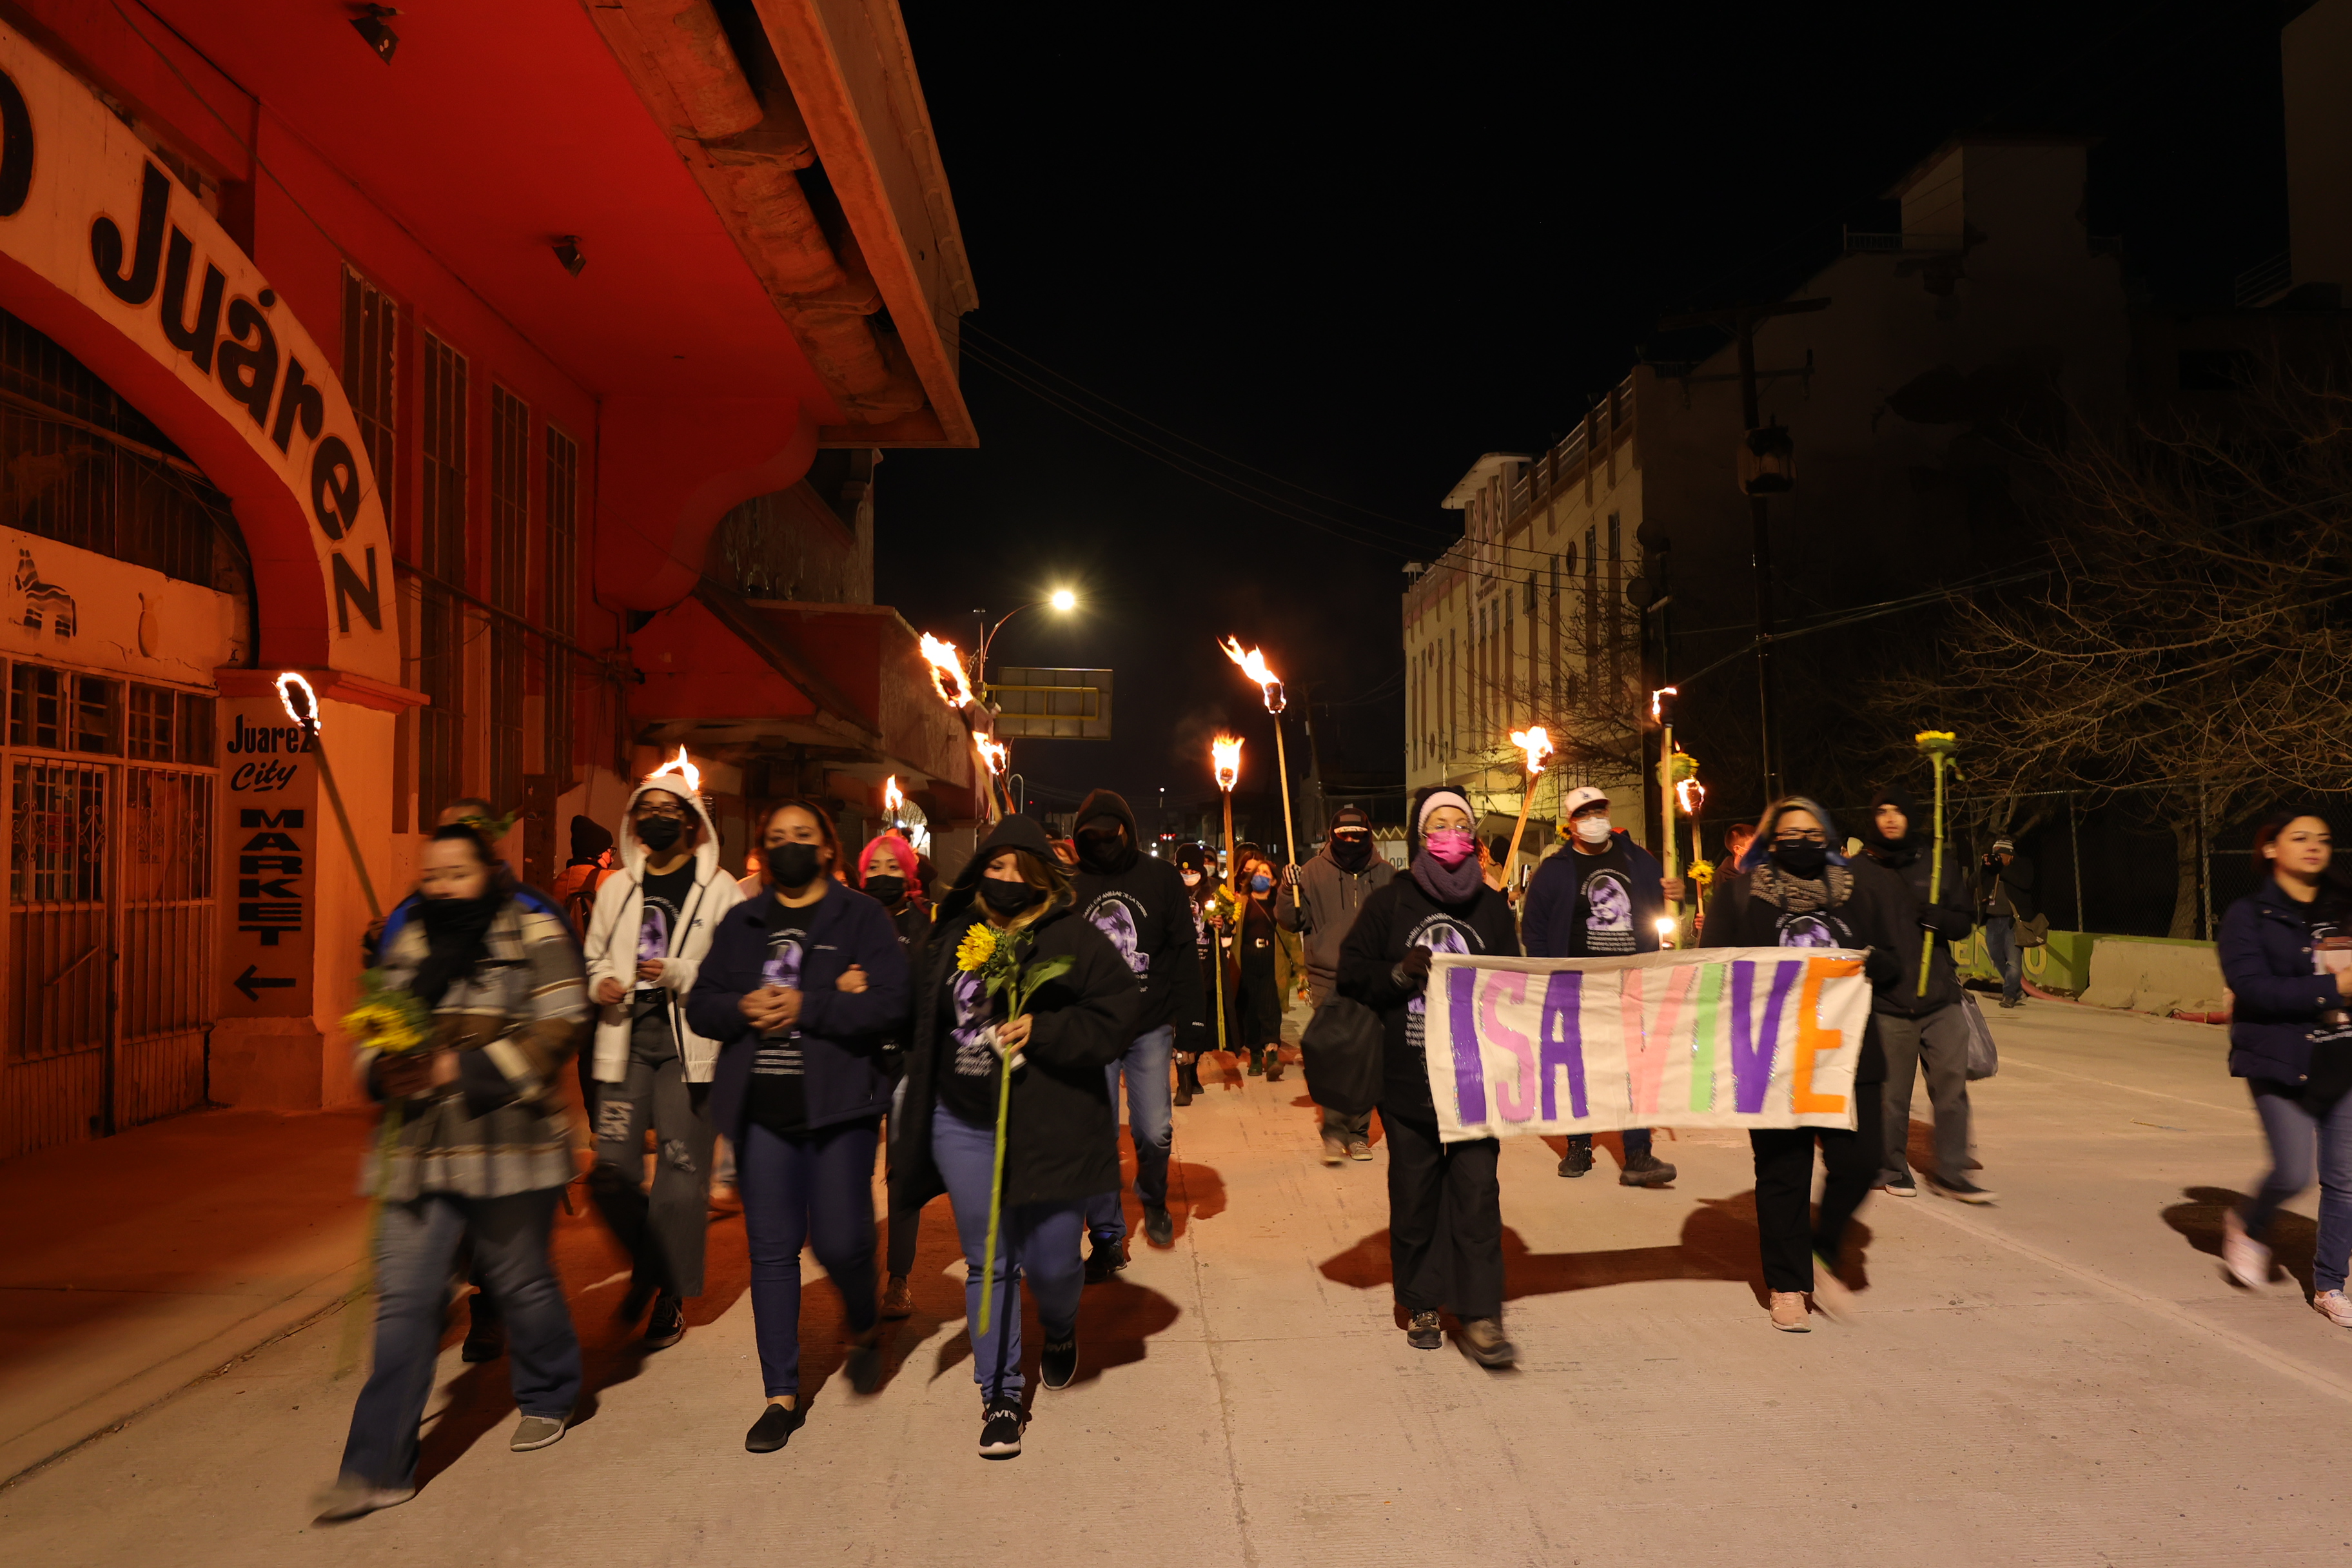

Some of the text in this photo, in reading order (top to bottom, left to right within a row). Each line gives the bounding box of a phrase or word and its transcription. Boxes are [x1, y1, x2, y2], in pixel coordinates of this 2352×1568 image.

[227, 714, 313, 754] Juarez
[231, 759, 298, 792] City
[239, 808, 304, 946] MARKET
[1446, 956, 1865, 1126] ISA VIVE
